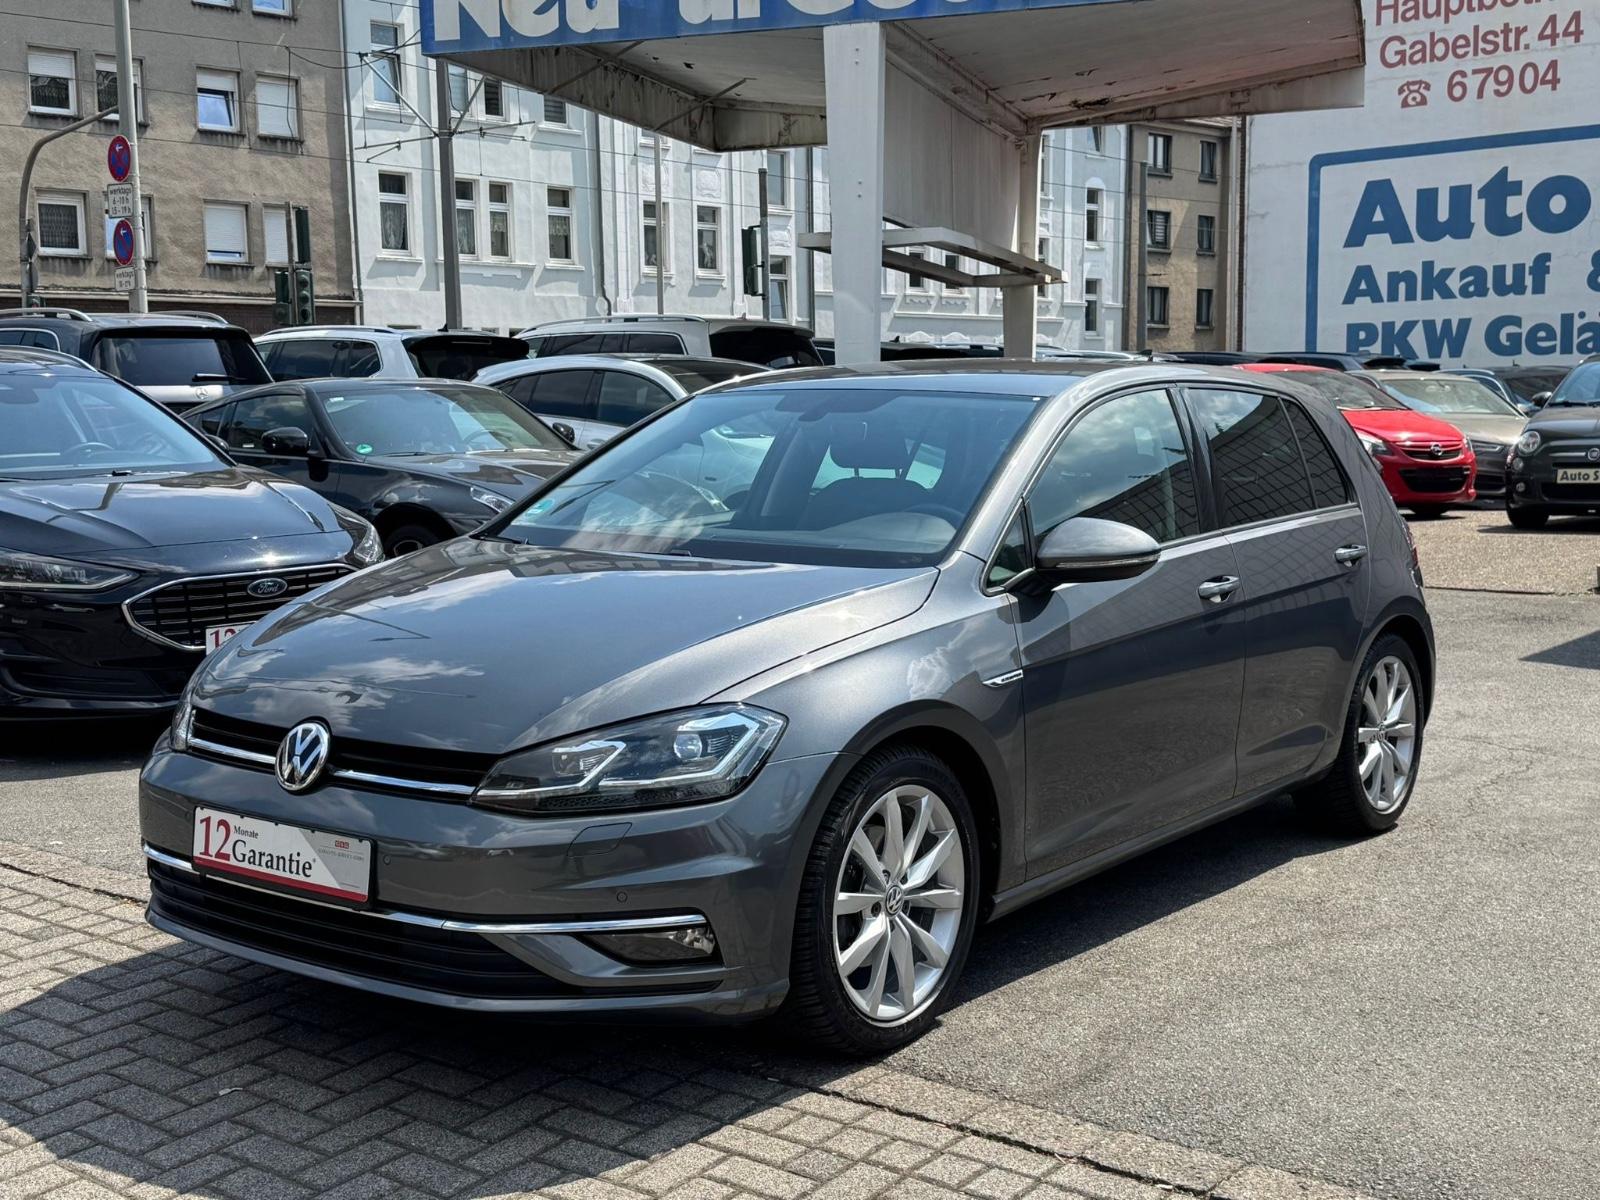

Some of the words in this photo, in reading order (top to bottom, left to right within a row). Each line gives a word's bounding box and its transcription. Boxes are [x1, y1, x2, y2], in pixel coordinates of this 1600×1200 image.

[1379, 24, 1530, 69] Gabelstr.
[1537, 10, 1584, 46] 44
[1343, 166, 1592, 248] Auto
[1341, 252, 1552, 305] Ankauf
[1346, 318, 1473, 359] PKW
[1560, 470, 1590, 481] Auto
[257, 579, 280, 594] Ford
[200, 815, 231, 862] 12
[233, 825, 260, 840] Monate
